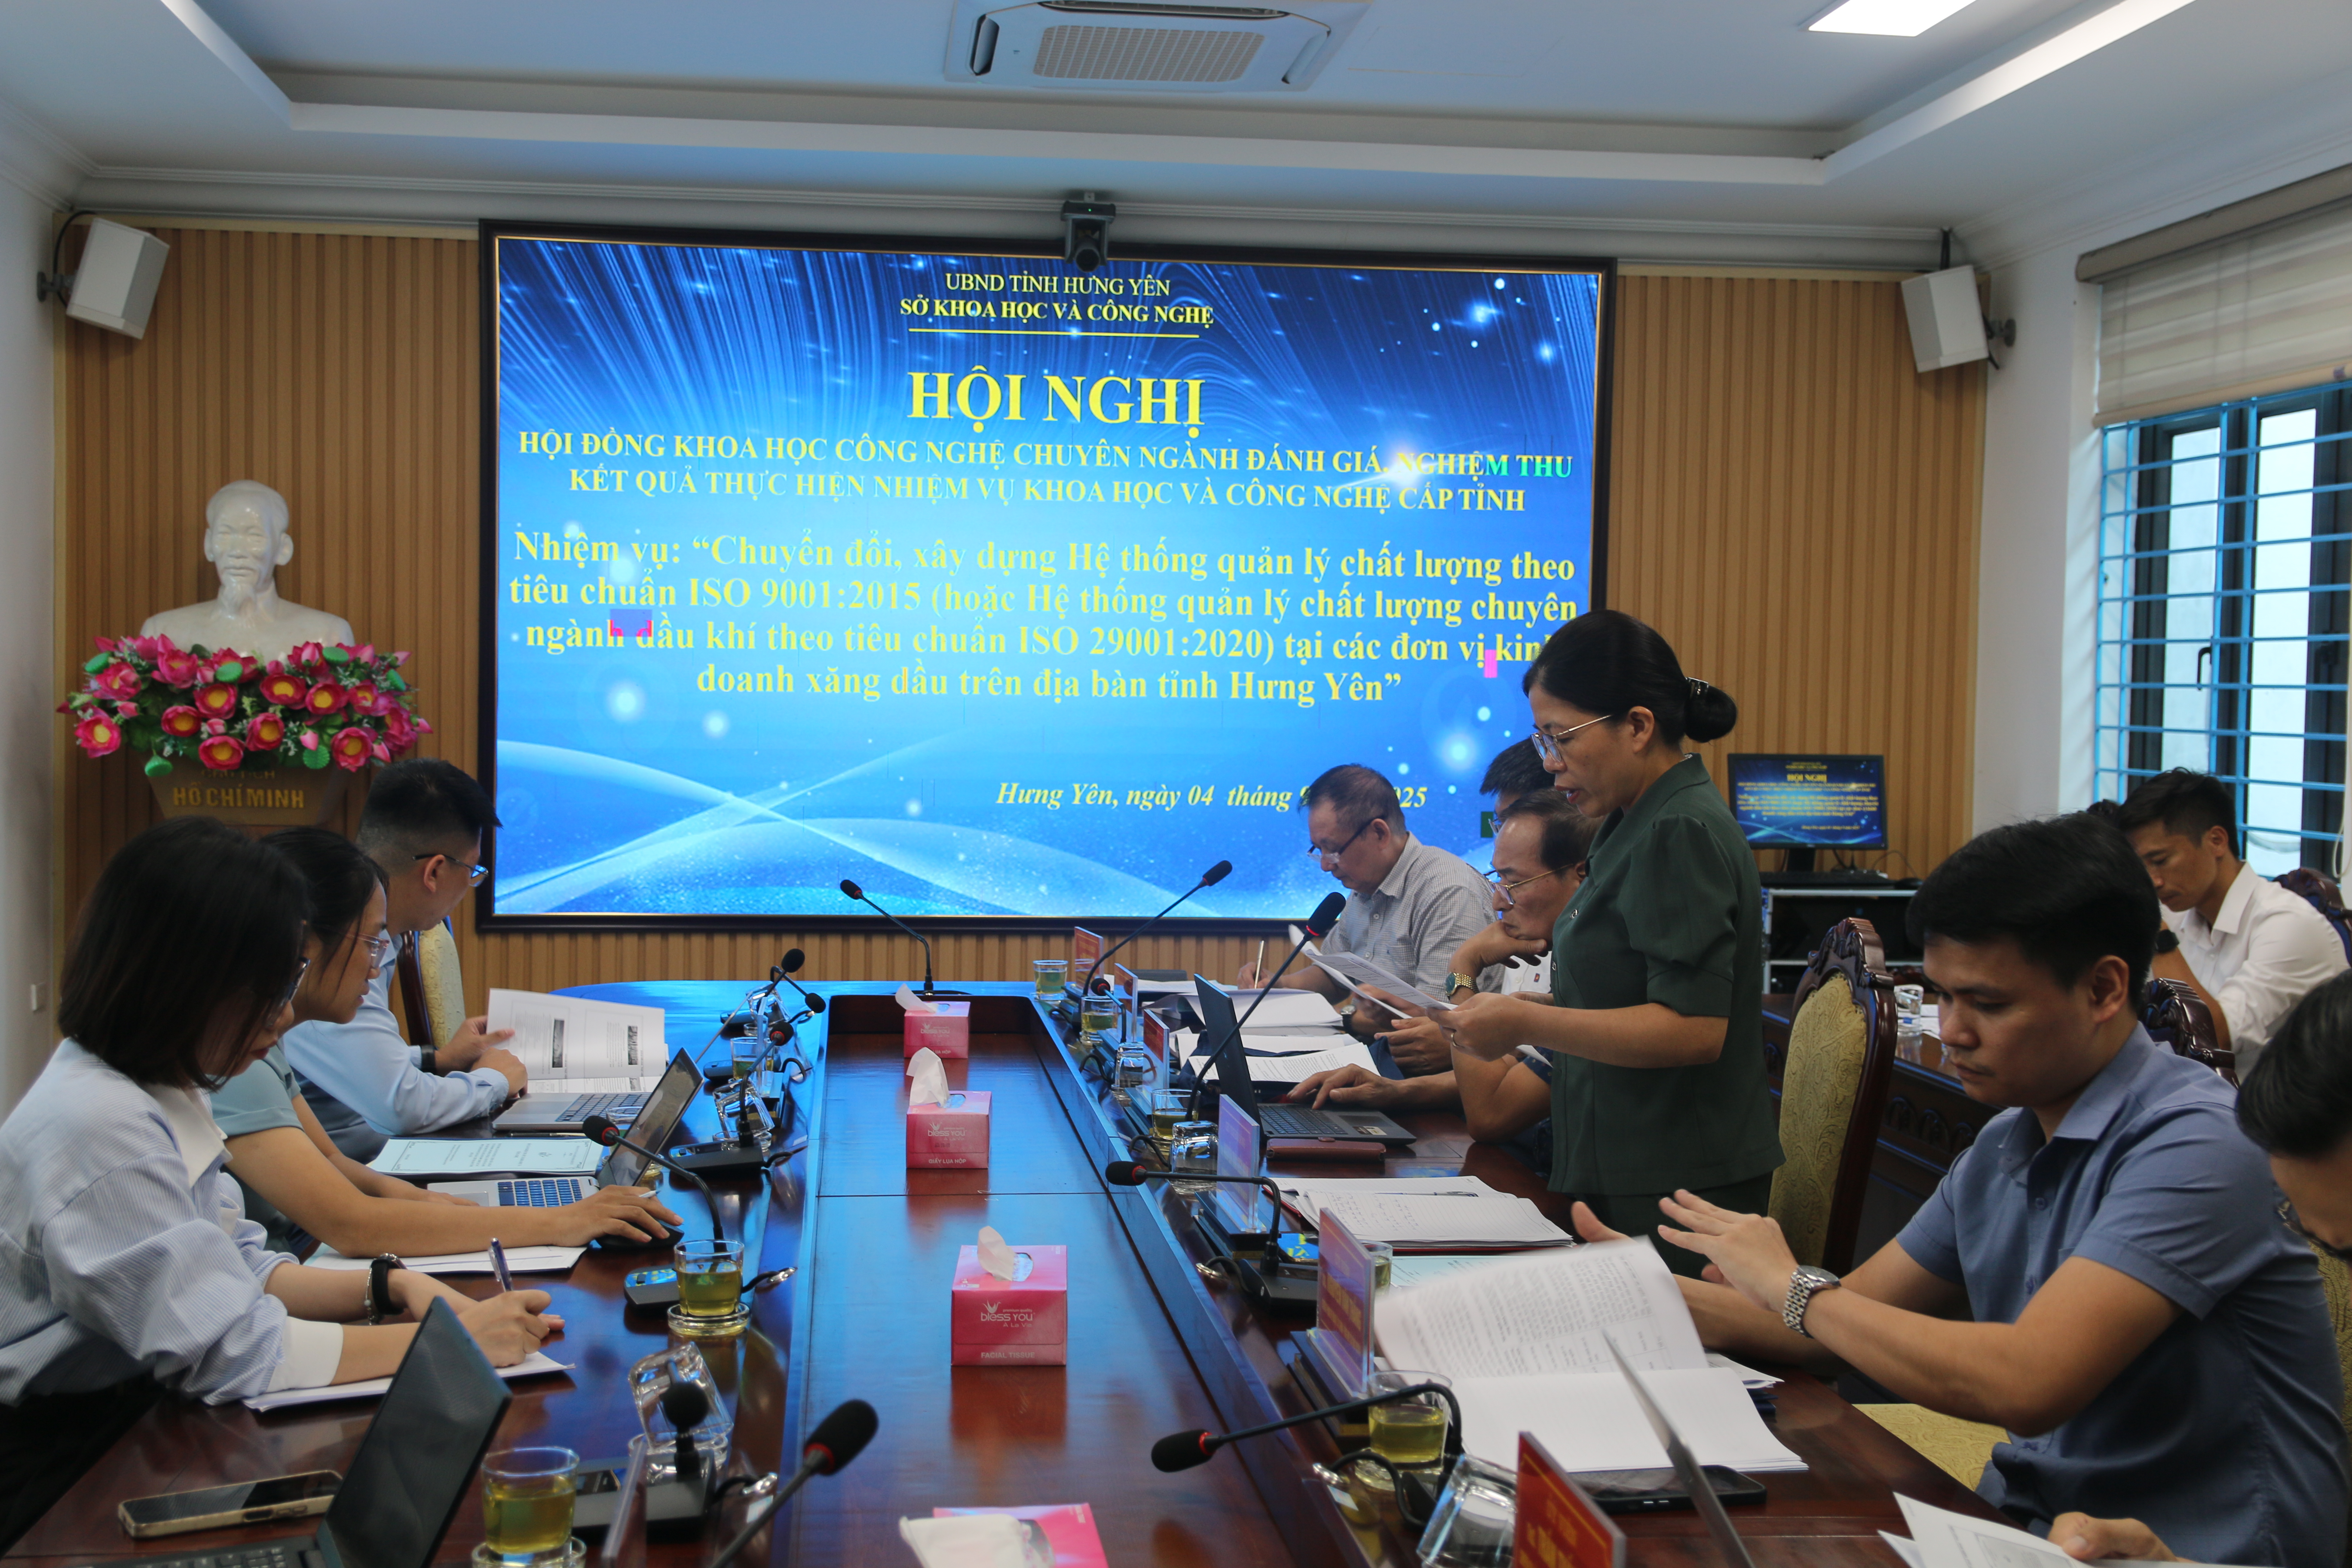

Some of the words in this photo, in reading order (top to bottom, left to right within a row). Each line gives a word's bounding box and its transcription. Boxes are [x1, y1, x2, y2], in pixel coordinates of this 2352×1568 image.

[946, 273, 1004, 291] UBND
[1009, 270, 1058, 293] TỈNH
[1064, 276, 1124, 294] HƯNG
[1129, 275, 1170, 296] YÊN
[900, 294, 929, 315] SỞ
[934, 300, 996, 317] KHOA
[1001, 301, 1047, 323] HỌC
[1053, 299, 1082, 320] VÀ
[1087, 299, 1149, 322] CÔNG
[1154, 306, 1213, 328] NGHỆ
[908, 365, 1026, 433] HỘI
[1043, 376, 1205, 438] NGHỊ
[520, 429, 572, 460] HỘI
[582, 428, 665, 456] ĐỒNG
[675, 436, 758, 458] KHOA
[766, 438, 827, 465] HỌC
[836, 433, 917, 462] CÔNG
[926, 440, 1004, 470] NGHỆ
[1014, 438, 1130, 466] CHUYÊN
[1140, 441, 1238, 469] NGÀNH
[1247, 443, 1324, 471] ĐÁNH
[1397, 451, 1510, 481] NGHIỆM
[1516, 455, 1573, 478] THU
[570, 463, 628, 491] KẾT
[636, 465, 697, 497] QUẢ
[705, 471, 787, 500] THỰC
[796, 475, 864, 502] HIỆN
[874, 474, 968, 504] NHIỆM
[977, 478, 1014, 505] VỤ
[1025, 480, 1105, 501] KHOA
[1113, 482, 1173, 508] HỌC
[1180, 477, 1217, 504] VÀ
[1226, 478, 1305, 506] CÔNG
[1314, 484, 1390, 514] NGHỆ
[1399, 482, 1454, 509] CẤP
[1458, 484, 1524, 511] TỈNH
[515, 532, 619, 568] Nhiệm
[631, 542, 680, 570] vụ:
[845, 530, 902, 571] đổi,
[914, 539, 966, 576] xây
[977, 541, 1057, 578] dựng
[1069, 542, 1110, 578] Hệ
[1120, 536, 1207, 581] thống
[1218, 547, 1292, 581] quản
[1305, 548, 1330, 582] lý
[1341, 541, 1405, 576] chất
[1415, 550, 1501, 586] lượng
[1511, 551, 1574, 579] theo
[510, 574, 568, 603] tiêu
[580, 568, 676, 605] chuẩn
[690, 578, 751, 606] ISO
[762, 579, 920, 610] 9001:2015
[931, 583, 1015, 618] (hoặc
[1027, 584, 1069, 619] Hệ
[1079, 578, 1167, 622] thống
[1177, 588, 1252, 622] quản
[1265, 589, 1290, 624] lý
[1300, 585, 1365, 618] chất
[1375, 591, 1462, 627] lượng
[1471, 592, 1577, 628] chuyên
[527, 619, 624, 654] ngành
[636, 612, 694, 649] dầu
[707, 622, 756, 649] khí
[767, 622, 833, 650] theo
[845, 623, 901, 651] tiêu
[913, 616, 1006, 653] chuẩn
[1019, 626, 1078, 654] ISO
[1090, 627, 1274, 663] 29001:2020)
[1285, 631, 1322, 665] tại
[1333, 632, 1381, 659] các
[1391, 633, 1448, 660] đơn
[1459, 634, 1484, 668] vị
[1496, 634, 1552, 661] kin
[698, 664, 794, 692] doanh
[807, 667, 880, 701] xăng
[891, 658, 947, 695] dầu
[959, 667, 1021, 695] trên
[1033, 669, 1079, 703] địa
[1092, 670, 1146, 697] bàn
[1158, 671, 1217, 698] tỉnh
[1231, 672, 1315, 707] Hưng
[173, 782, 202, 806] HỒ
[206, 783, 242, 807] CHÍ
[246, 788, 305, 808] MINH
[997, 783, 1063, 808] Hưng
[1073, 783, 1118, 806] Yên,
[1126, 784, 1181, 811] ngày
[1188, 785, 1215, 806] 04
[1227, 785, 1293, 812] tháng
[1393, 787, 1428, 808] 25
[981, 1312, 1011, 1321] bless
